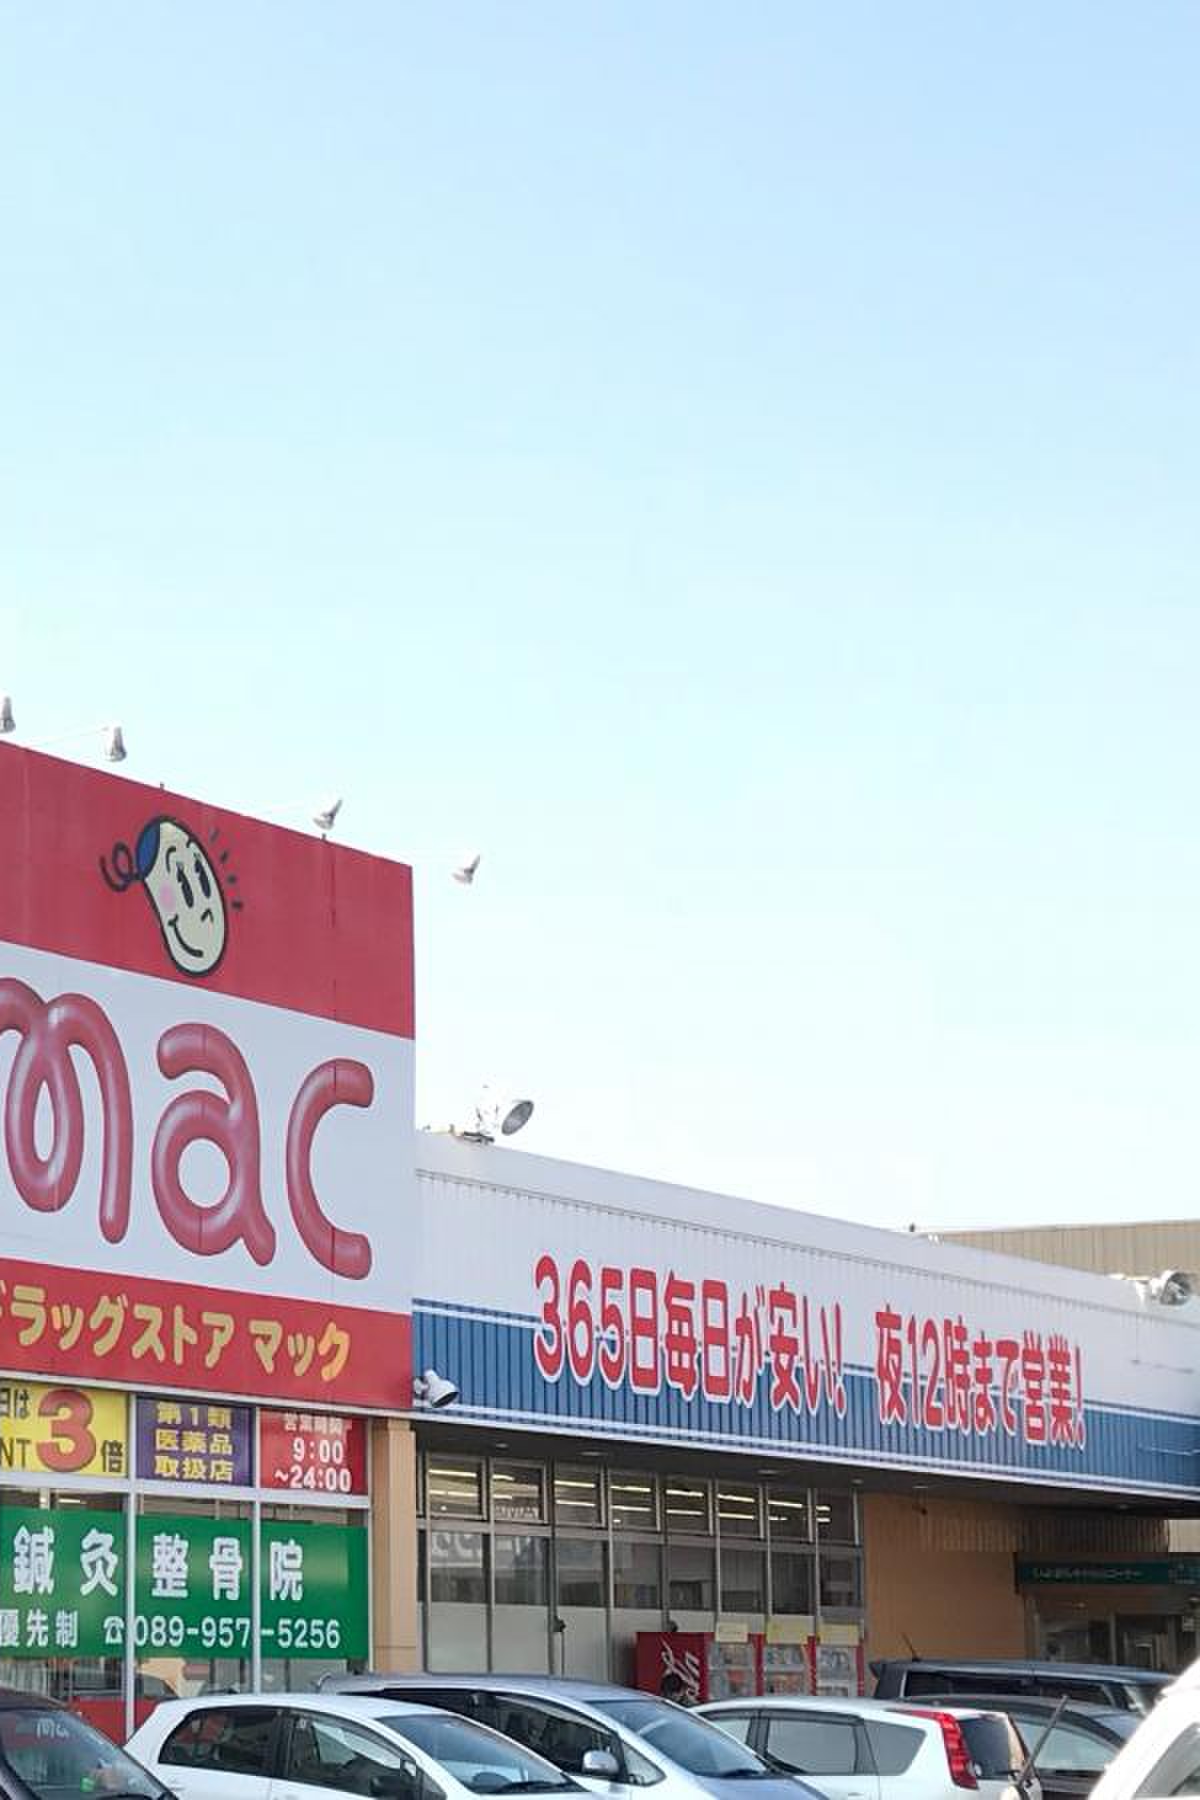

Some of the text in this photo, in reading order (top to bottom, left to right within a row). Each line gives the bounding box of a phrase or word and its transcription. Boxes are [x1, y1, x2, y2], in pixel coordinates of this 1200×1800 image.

[248, 1319, 351, 1382] マック
[155, 1428, 233, 1456] 医薬品
[293, 1437, 344, 1464] 9:00
[154, 1455, 234, 1482] 取扱店
[135, 1615, 341, 1651] 089-957-5256
